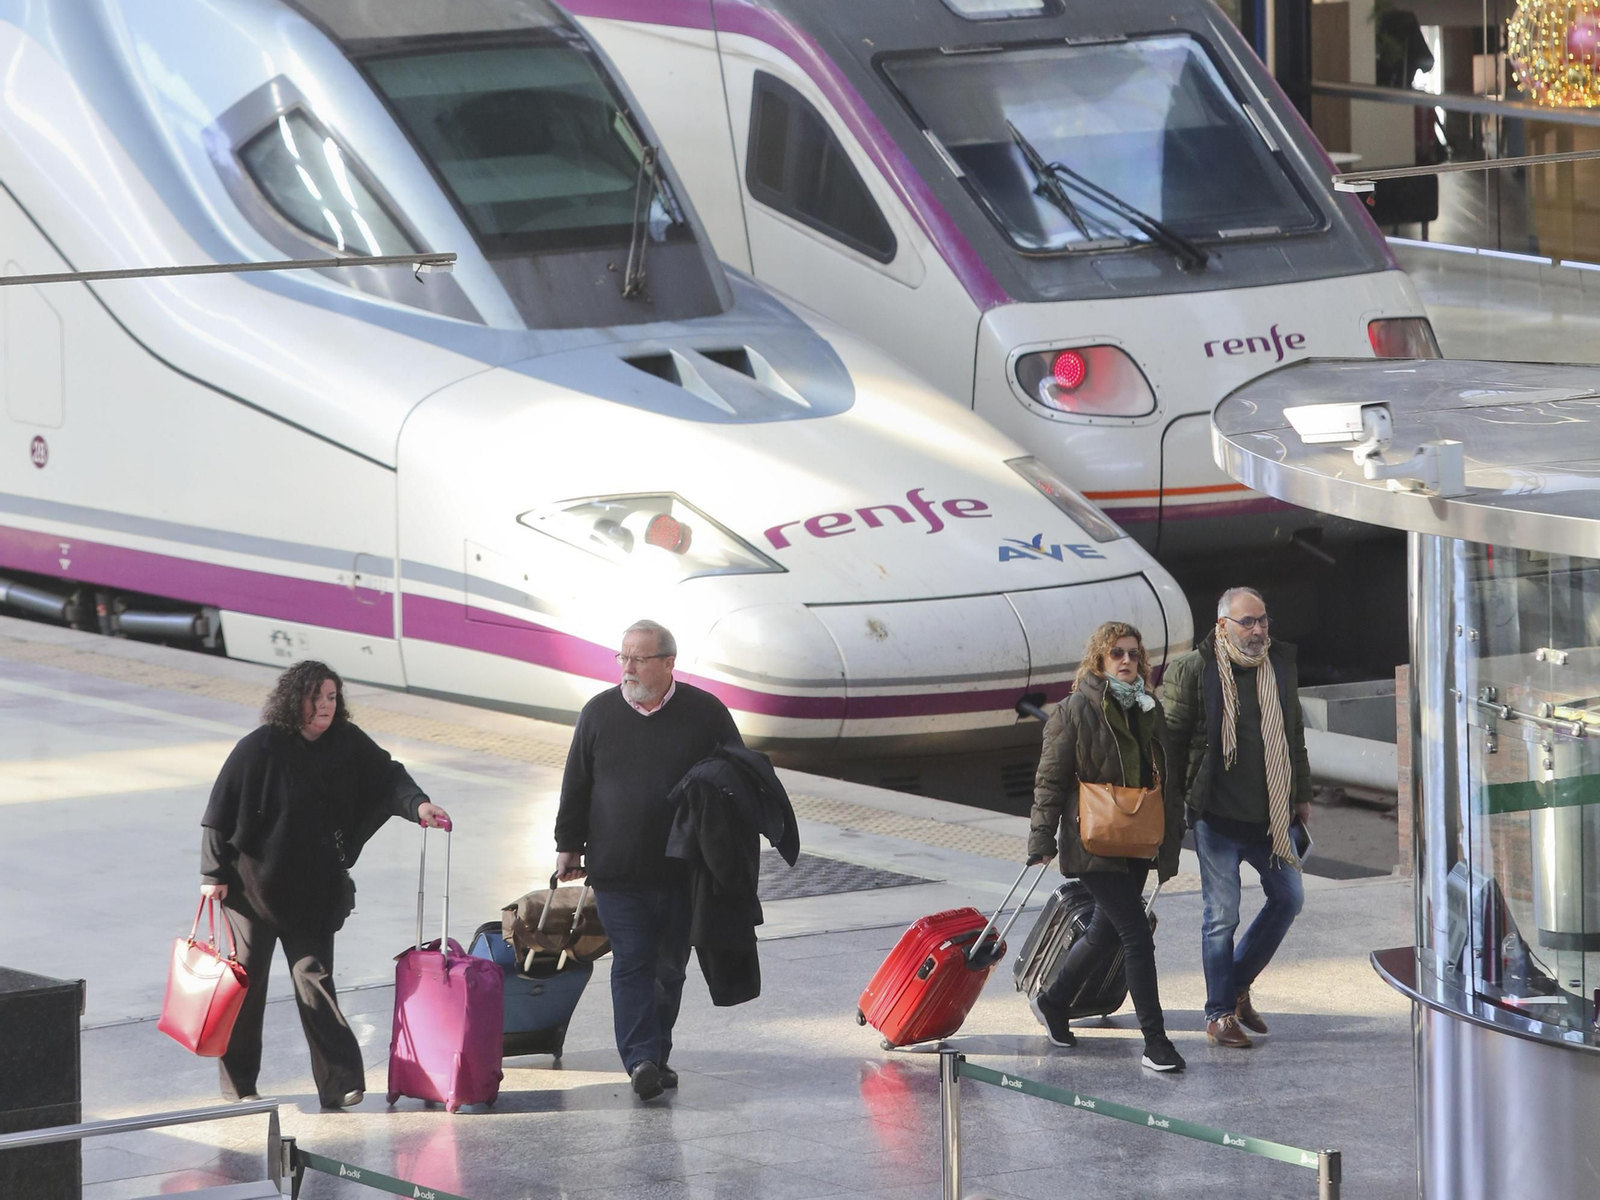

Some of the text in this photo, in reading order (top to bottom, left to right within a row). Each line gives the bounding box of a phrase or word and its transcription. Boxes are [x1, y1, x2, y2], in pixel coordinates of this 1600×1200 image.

[1203, 323, 1307, 363] renfe
[763, 487, 993, 551] renfe
[998, 533, 1108, 563] AVE
[1008, 1079, 1023, 1089] adif
[1081, 1099, 1095, 1109] adif
[1154, 1119, 1170, 1129] adif
[1230, 1138, 1246, 1148] adif
[346, 1168, 361, 1179] adif
[420, 1190, 435, 1200] adif
